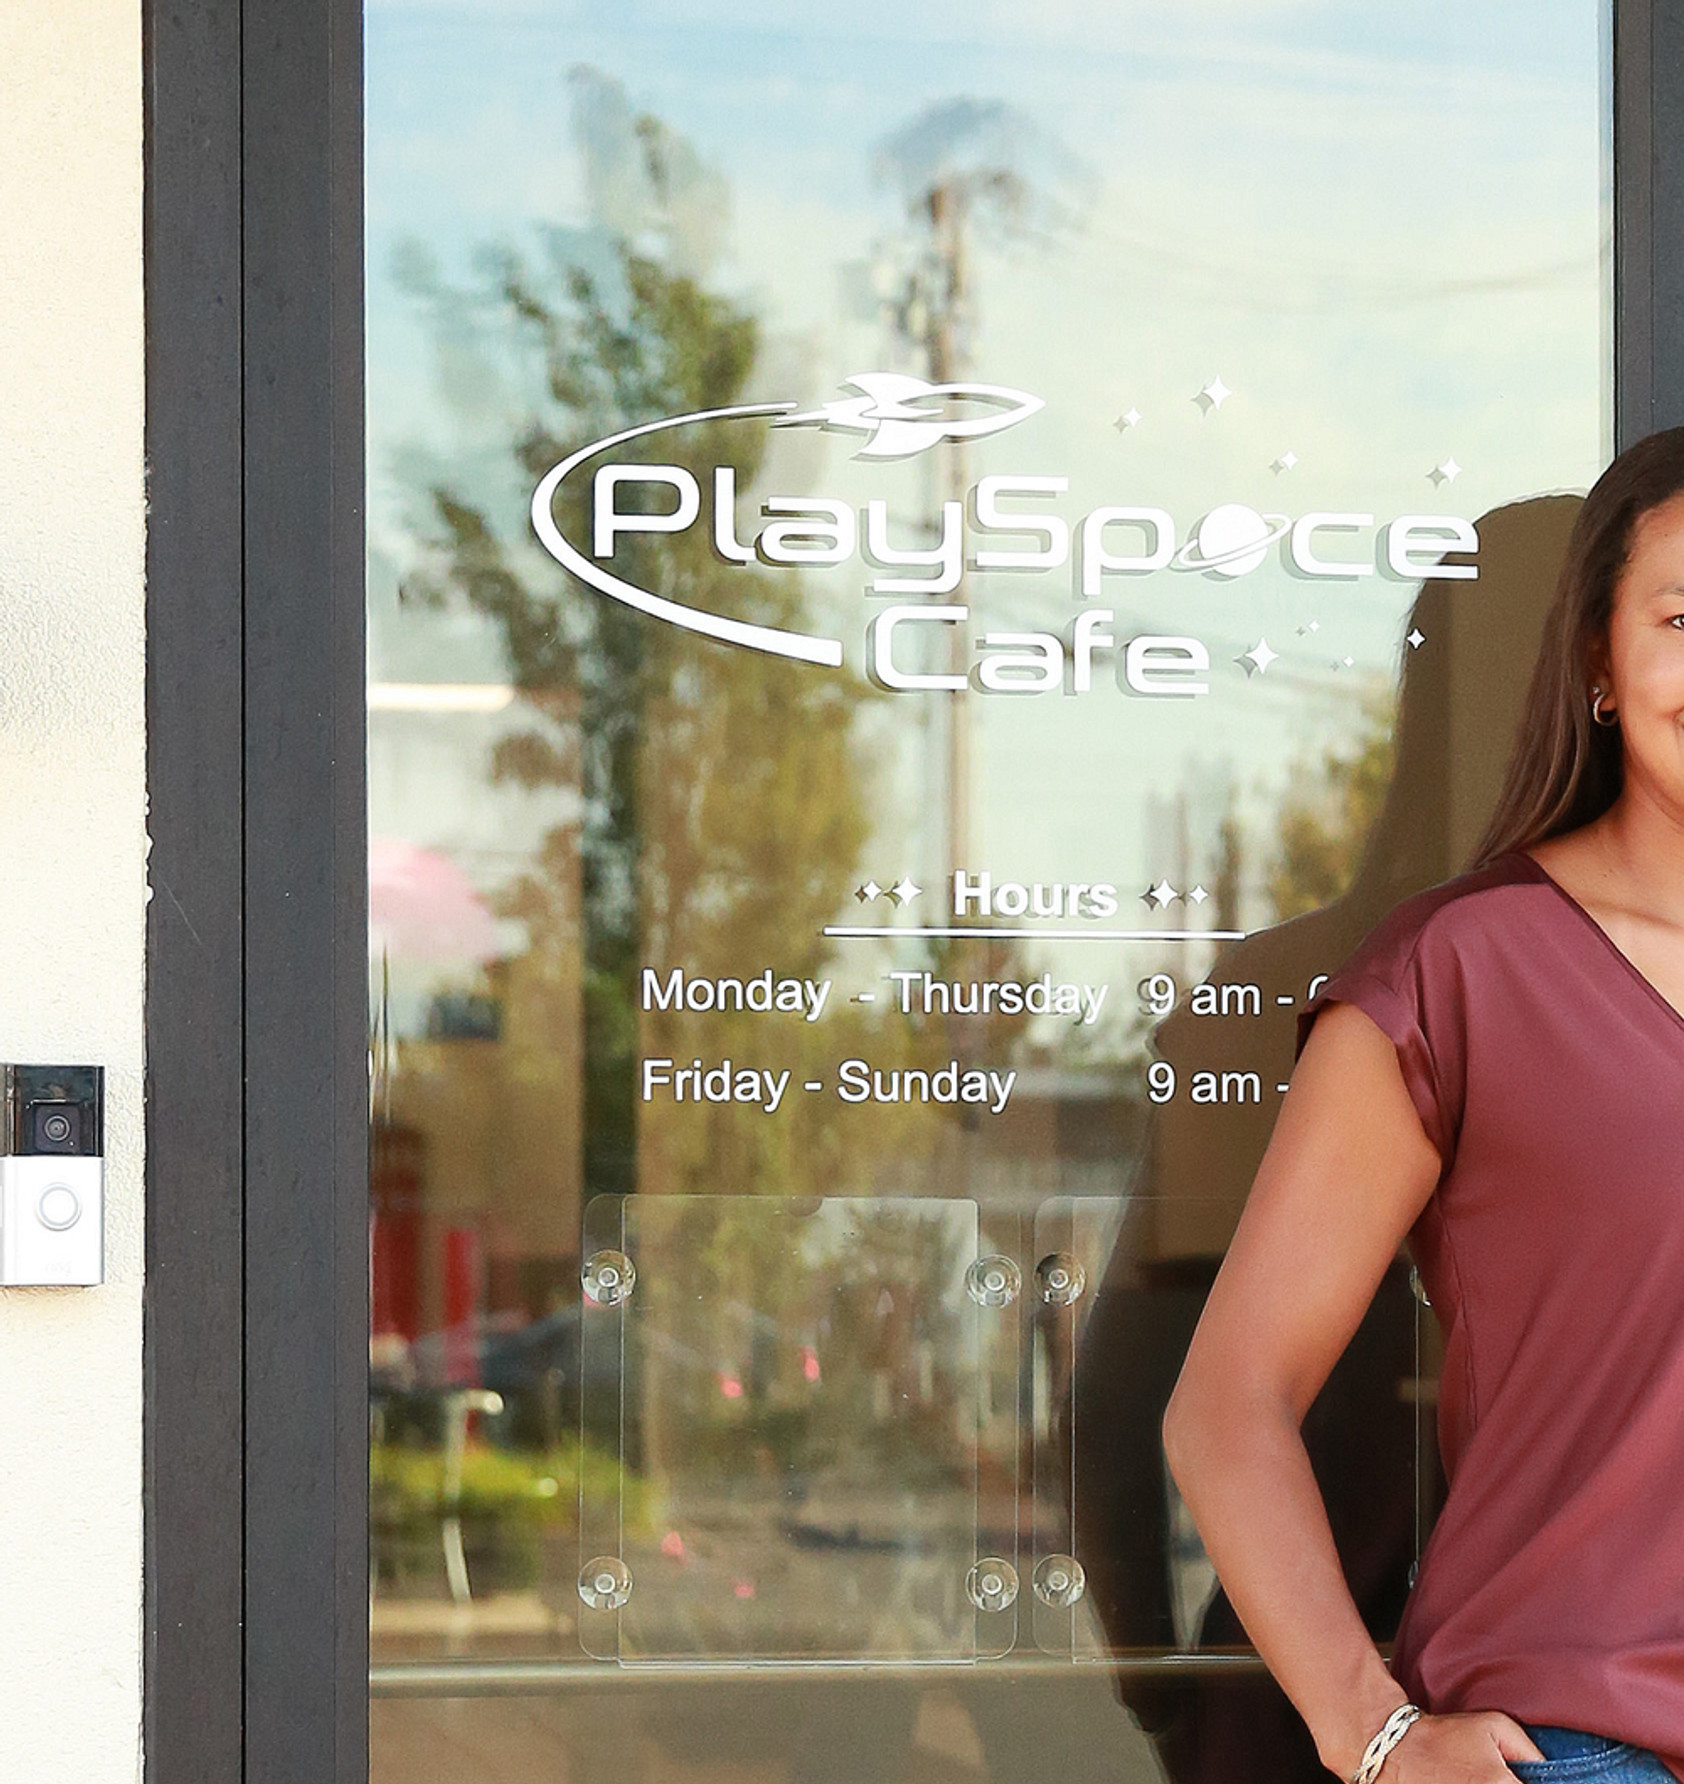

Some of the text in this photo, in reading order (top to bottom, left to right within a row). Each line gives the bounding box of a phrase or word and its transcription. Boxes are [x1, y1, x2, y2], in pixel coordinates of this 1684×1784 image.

[874, 604, 1210, 695] Cafe
[954, 869, 1119, 918] Hours
[642, 969, 832, 1023] Monday
[889, 971, 1109, 1025] Thursday
[1148, 974, 1175, 1016] 9
[1191, 983, 1261, 1016] am
[642, 1059, 790, 1110] Friday
[837, 1060, 1017, 1113] Sunday
[1148, 1063, 1175, 1103] 9
[1191, 1071, 1261, 1104] am
